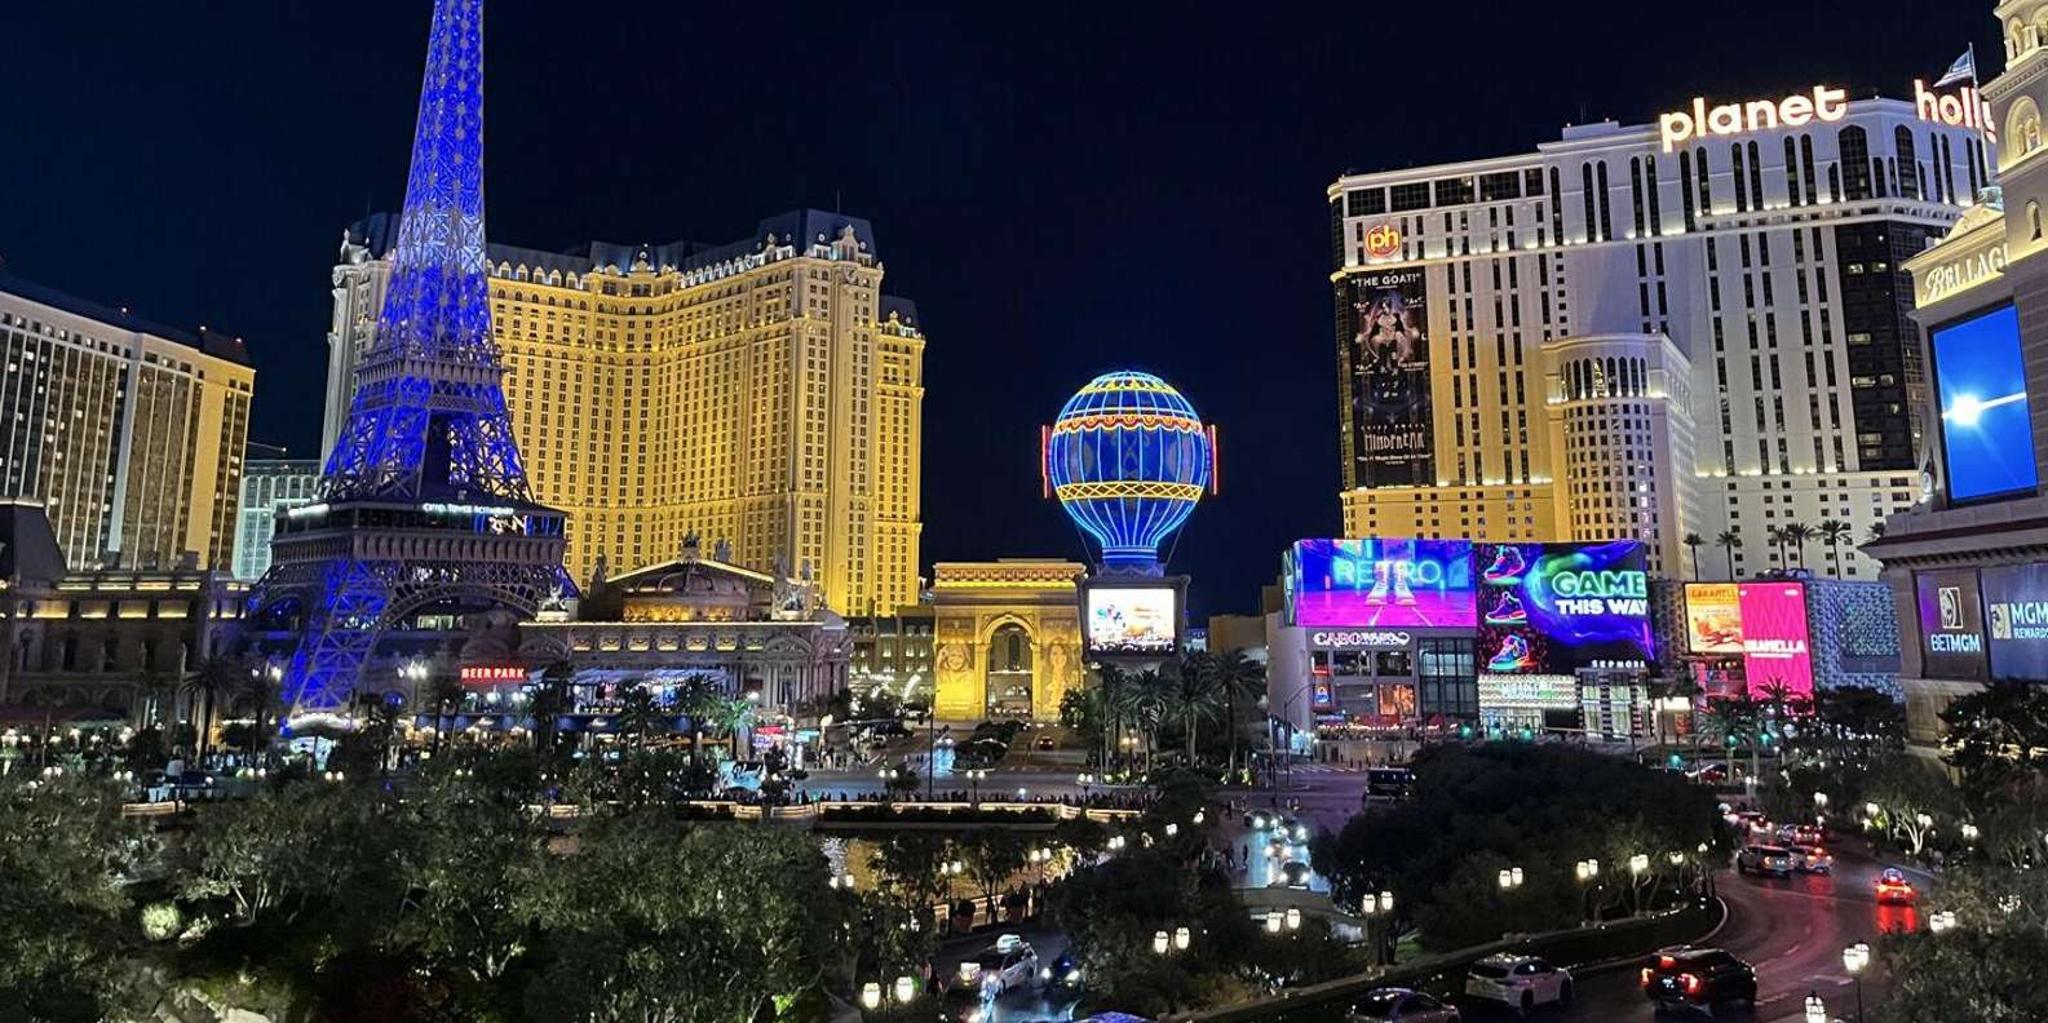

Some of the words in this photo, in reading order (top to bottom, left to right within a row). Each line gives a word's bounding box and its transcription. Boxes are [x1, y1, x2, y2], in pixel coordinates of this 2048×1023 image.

[1660, 85, 1847, 153] planet
[1370, 224, 1398, 251] ph
[1333, 557, 1440, 584] RETRO
[1552, 570, 1647, 598] GAME
[1555, 599, 1604, 615] THIS
[1607, 599, 1647, 615] WAY
[2010, 602, 2048, 624] MGM
[1931, 634, 1981, 652] BETMGM
[462, 668, 491, 678] BEER
[494, 668, 524, 678] PARK
[1592, 660, 1645, 668] SEPHORA
